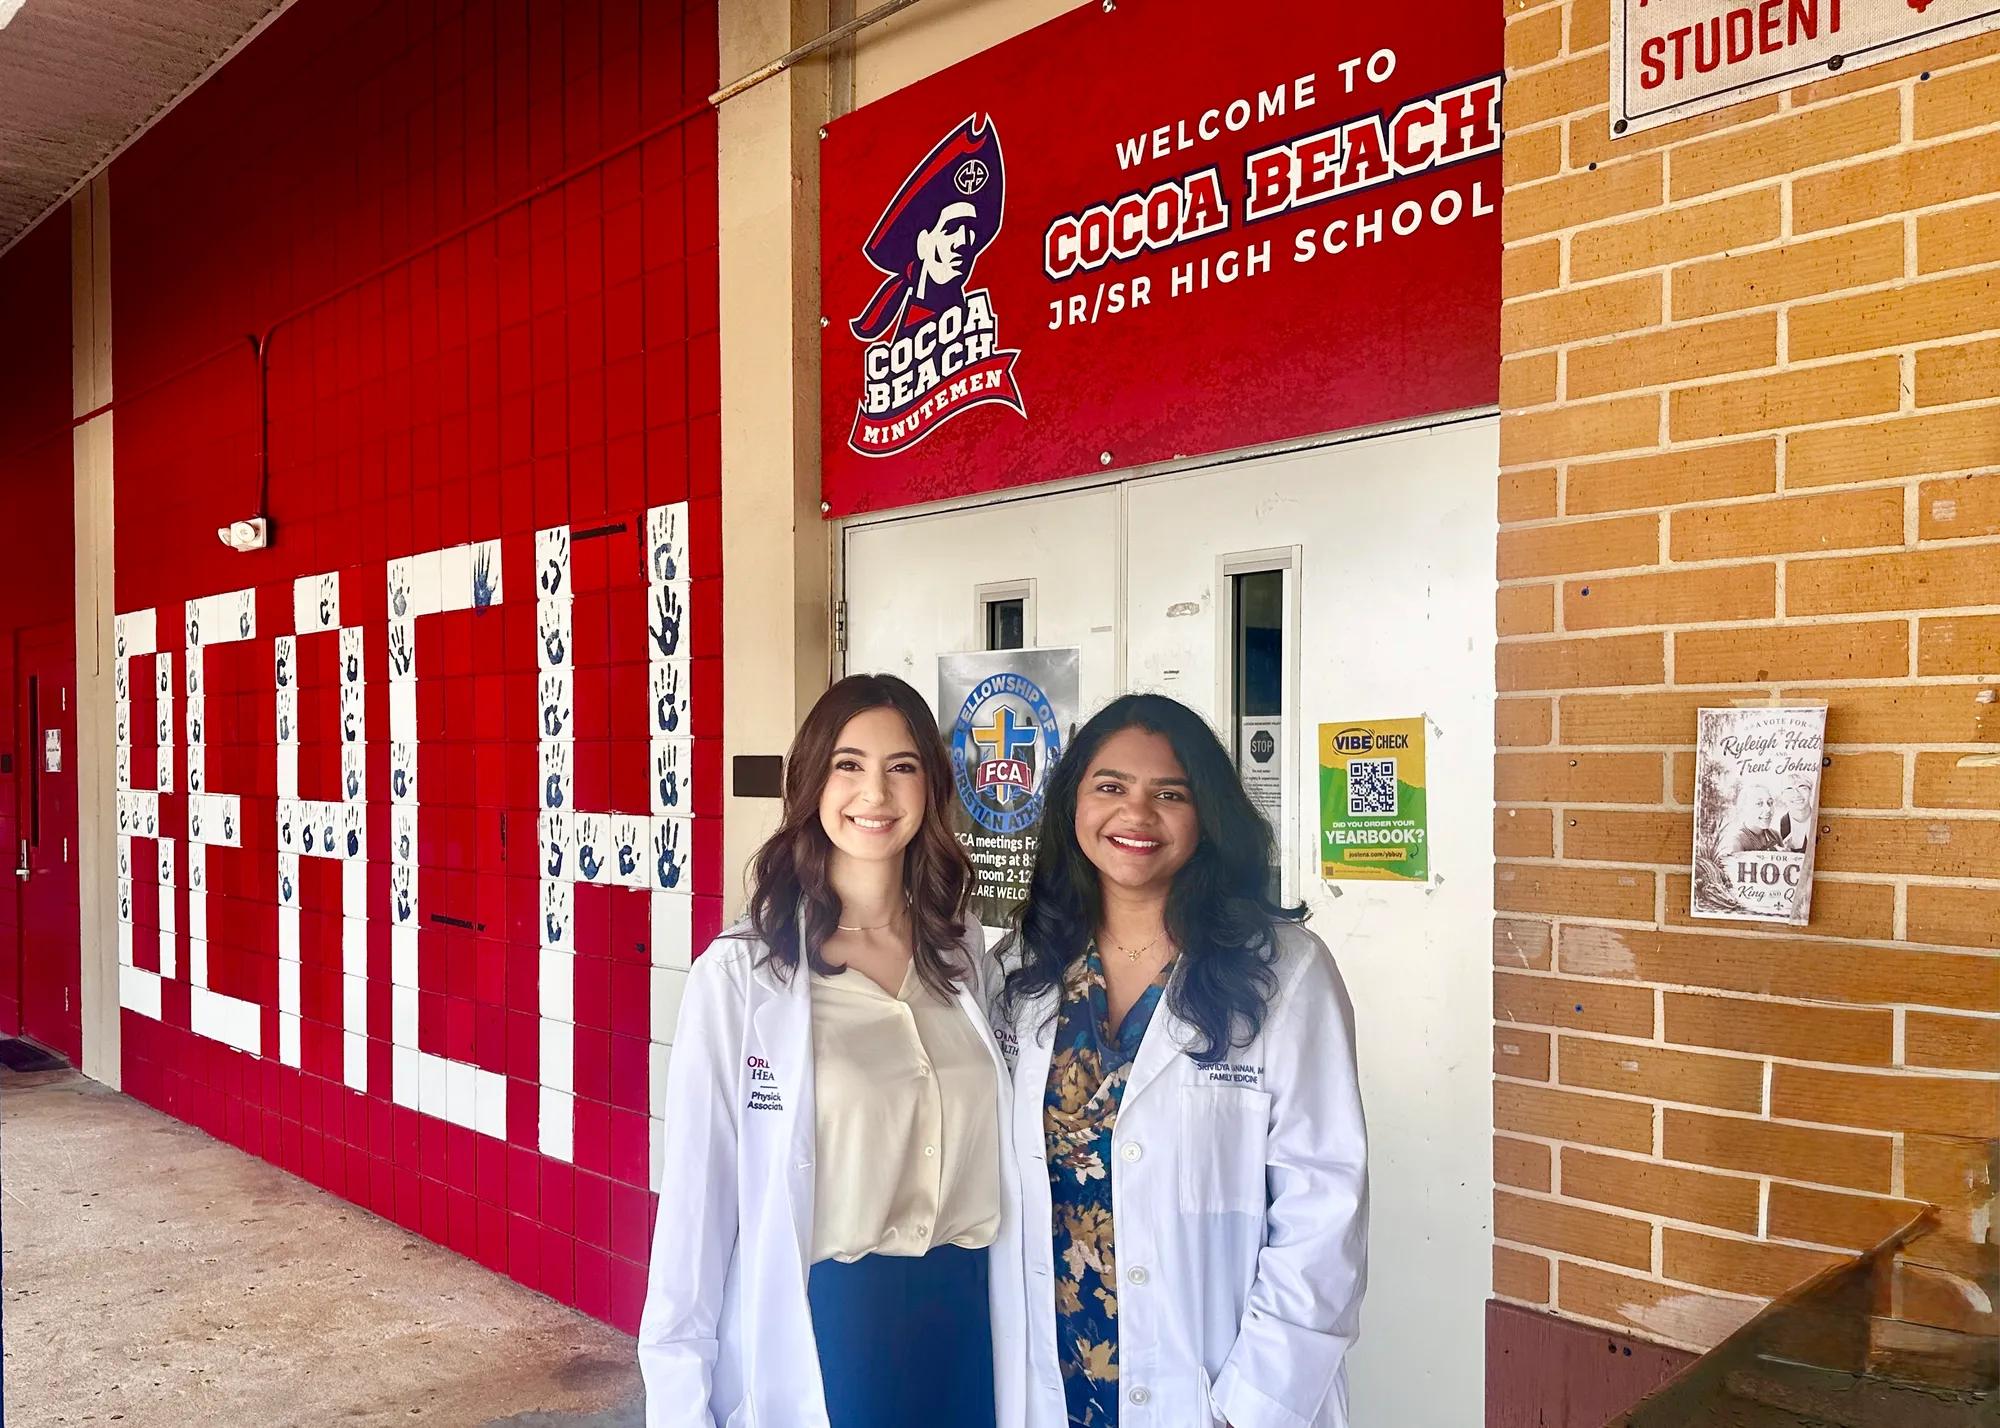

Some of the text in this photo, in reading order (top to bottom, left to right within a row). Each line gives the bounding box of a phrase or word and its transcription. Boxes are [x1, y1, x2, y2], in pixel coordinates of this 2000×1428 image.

[1115, 48, 1397, 171] WELCOME TO
[1046, 76, 1503, 280] COCOA BEACH
[1048, 181, 1495, 331] JR/SR HIGH SCHOOL
[867, 294, 994, 381] COCOA
[867, 332, 994, 414] BEACH
[862, 368, 1003, 445] MINUTEMEN
[957, 675, 1056, 733] ELLOWSHIP OF
[1763, 718, 1785, 726] VOTE
[1790, 719, 1808, 727] FOR
[1251, 740, 1273, 753] STOP
[1335, 734, 1409, 750] VIBE CHECK
[1720, 732, 1778, 759] Ryleigh
[985, 761, 1023, 783] FCA
[1736, 758, 1772, 776] Trent
[975, 834, 1023, 852] meetings
[1325, 829, 1425, 844] YEARBOOK?
[1008, 854, 1021, 866] at
[978, 869, 1005, 882] room
[1737, 862, 1801, 887] HOC
[977, 884, 995, 898] ARE
[1737, 885, 1766, 902] King
